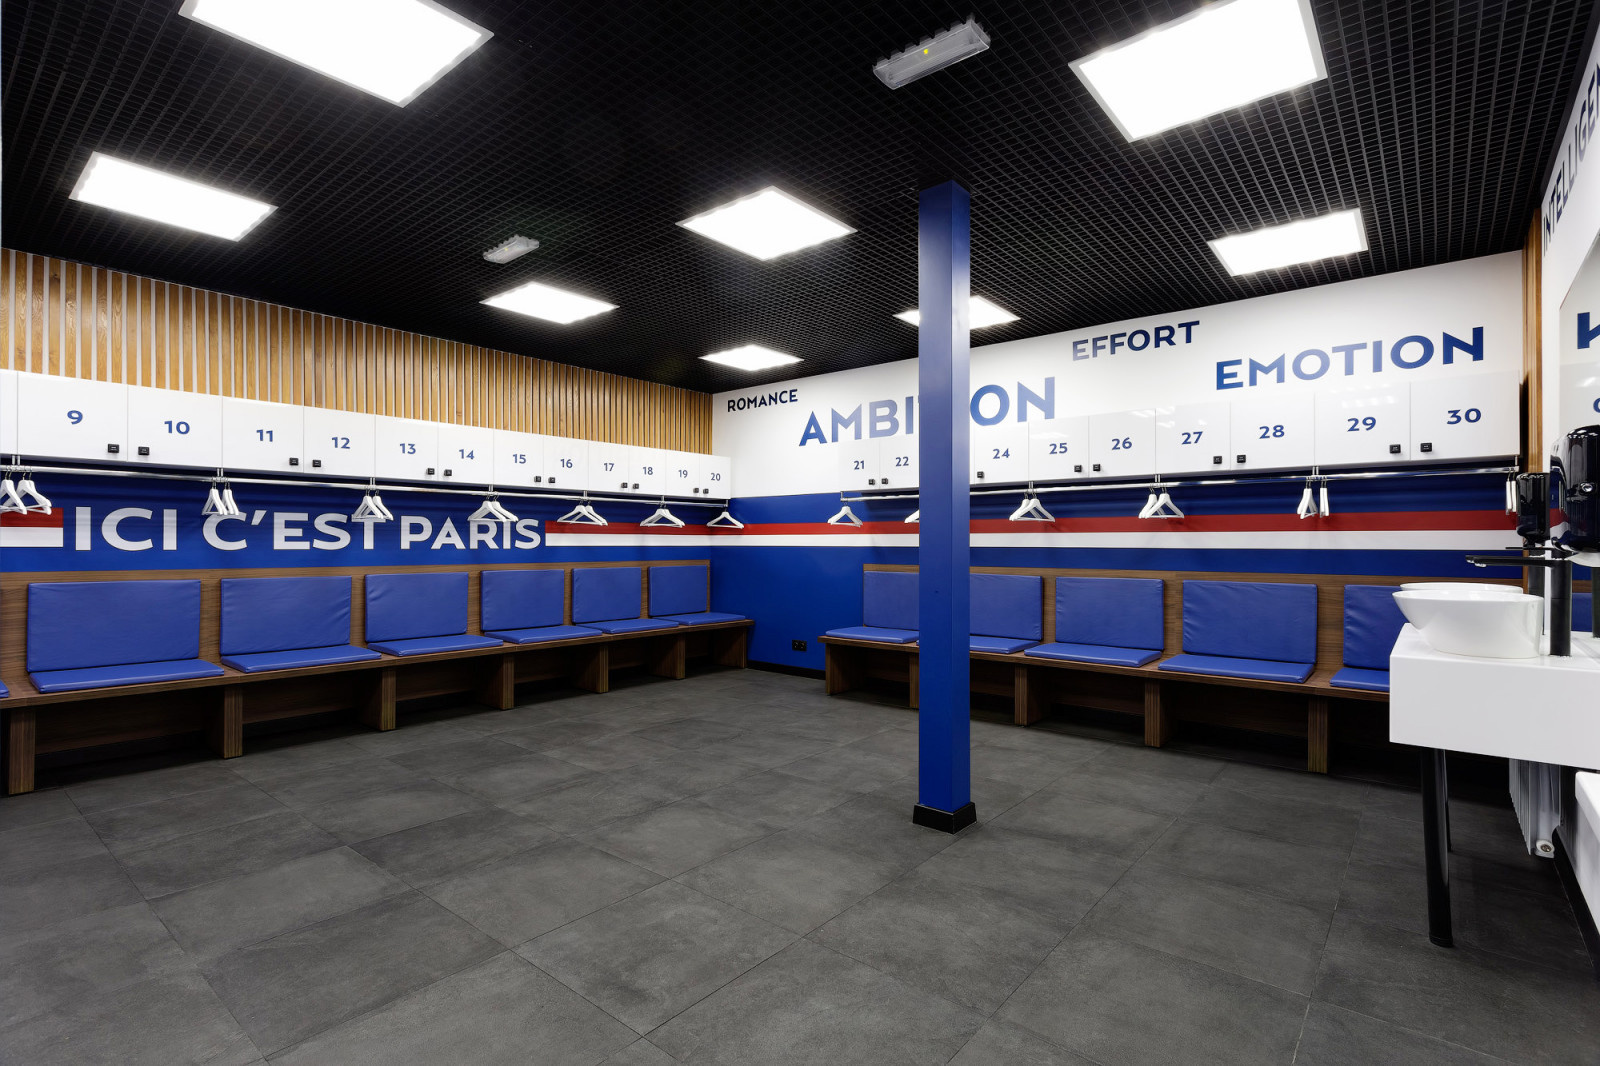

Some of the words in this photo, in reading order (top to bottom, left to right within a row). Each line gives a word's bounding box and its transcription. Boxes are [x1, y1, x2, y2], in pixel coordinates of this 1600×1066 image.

[1072, 320, 1200, 361] EFFORT
[1216, 326, 1485, 390] EMOTION
[727, 388, 798, 413] ROMANCE
[66, 409, 84, 425] 9
[799, 377, 1055, 447] AMBION
[1446, 408, 1482, 425] 30
[163, 420, 191, 435] 10
[1347, 416, 1377, 432] 29
[255, 429, 274, 443] 11
[1181, 431, 1204, 445] 27
[1258, 424, 1285, 439] 28
[331, 436, 351, 450] 12
[399, 442, 417, 455] 13
[1049, 442, 1068, 455] 25
[1111, 437, 1133, 451] 26
[458, 448, 475, 460] 14
[512, 453, 527, 465] 15
[992, 448, 1011, 460] 24
[560, 458, 573, 469] 16
[603, 462, 615, 472] 17
[853, 460, 865, 470] 21
[895, 456, 909, 467] 22
[642, 466, 653, 476] 18
[678, 469, 689, 479] 19
[710, 472, 721, 482] 20
[75, 506, 178, 551] ICI
[202, 509, 386, 551] C'EST
[400, 515, 541, 550] PARIS
